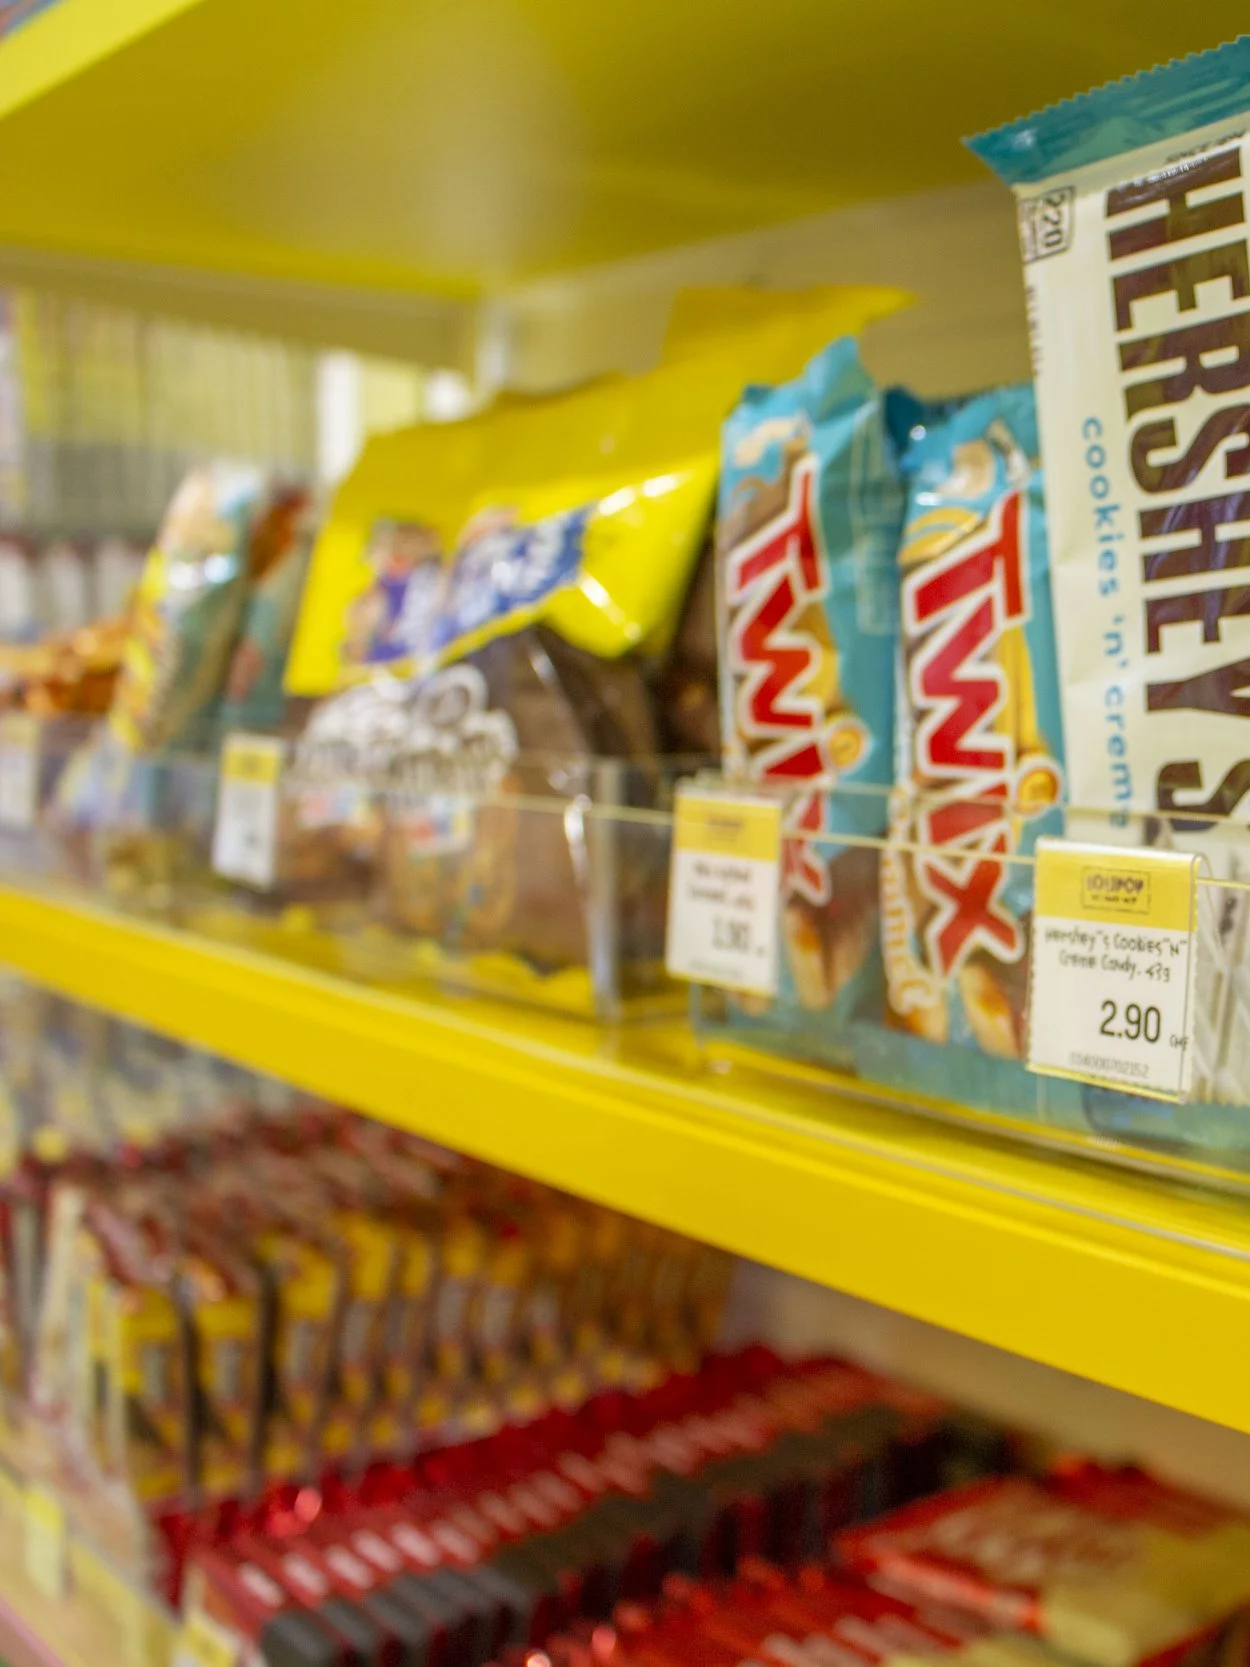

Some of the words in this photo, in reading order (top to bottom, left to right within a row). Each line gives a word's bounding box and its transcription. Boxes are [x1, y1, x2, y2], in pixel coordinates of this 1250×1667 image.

[908, 487, 1030, 978] TWIX
[1082, 416, 1124, 598] cookies
[1106, 686, 1134, 829] creme
[1100, 999, 1162, 1044] 2.90
